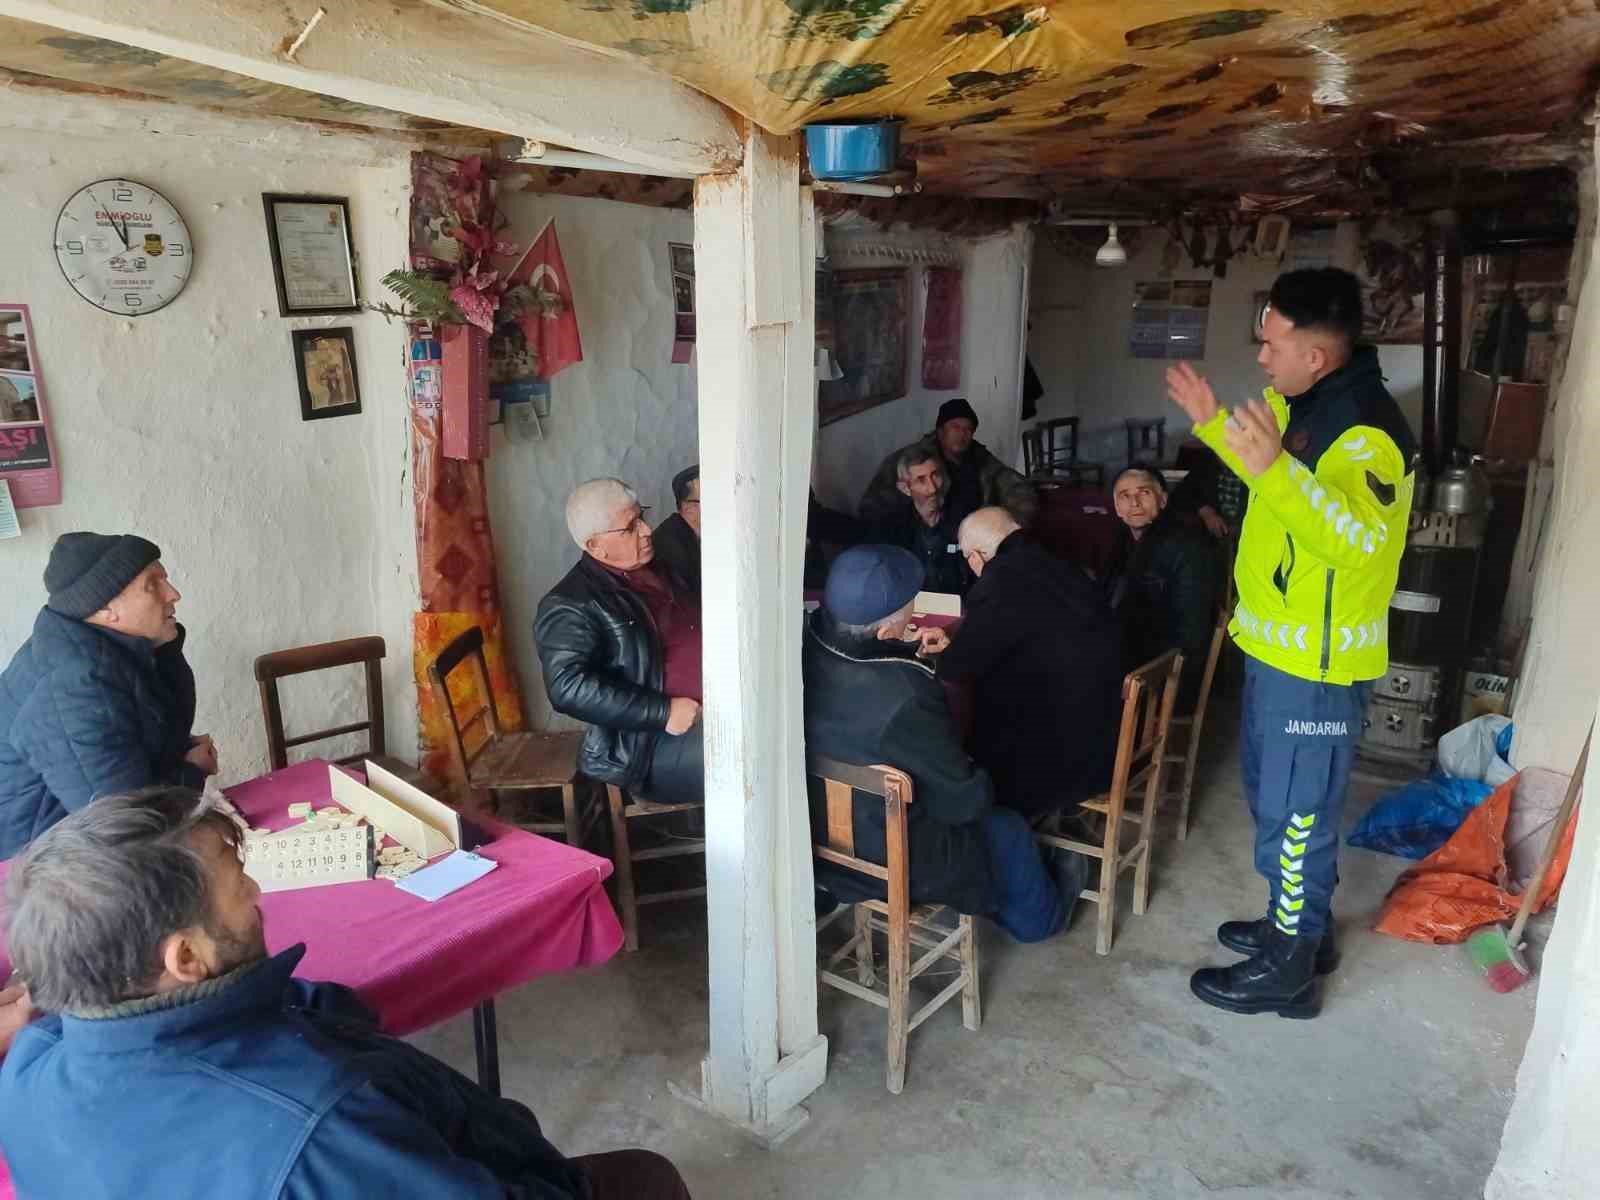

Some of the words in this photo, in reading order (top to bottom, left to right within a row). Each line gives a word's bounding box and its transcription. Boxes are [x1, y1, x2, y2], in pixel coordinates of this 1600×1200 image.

[112, 188, 133, 202] 12
[66, 240, 84, 255] 9
[167, 243, 184, 257] 3
[124, 292, 142, 306] 6
[1285, 720, 1348, 736] JANDARMA
[276, 839, 287, 849] 10
[293, 838, 301, 847] 2
[309, 837, 316, 846] 3
[324, 833, 332, 842] 4
[340, 832, 347, 841] 5
[291, 859, 303, 869] 12
[308, 856, 317, 866] 11
[323, 855, 333, 865] 10
[339, 853, 347, 863] 9
